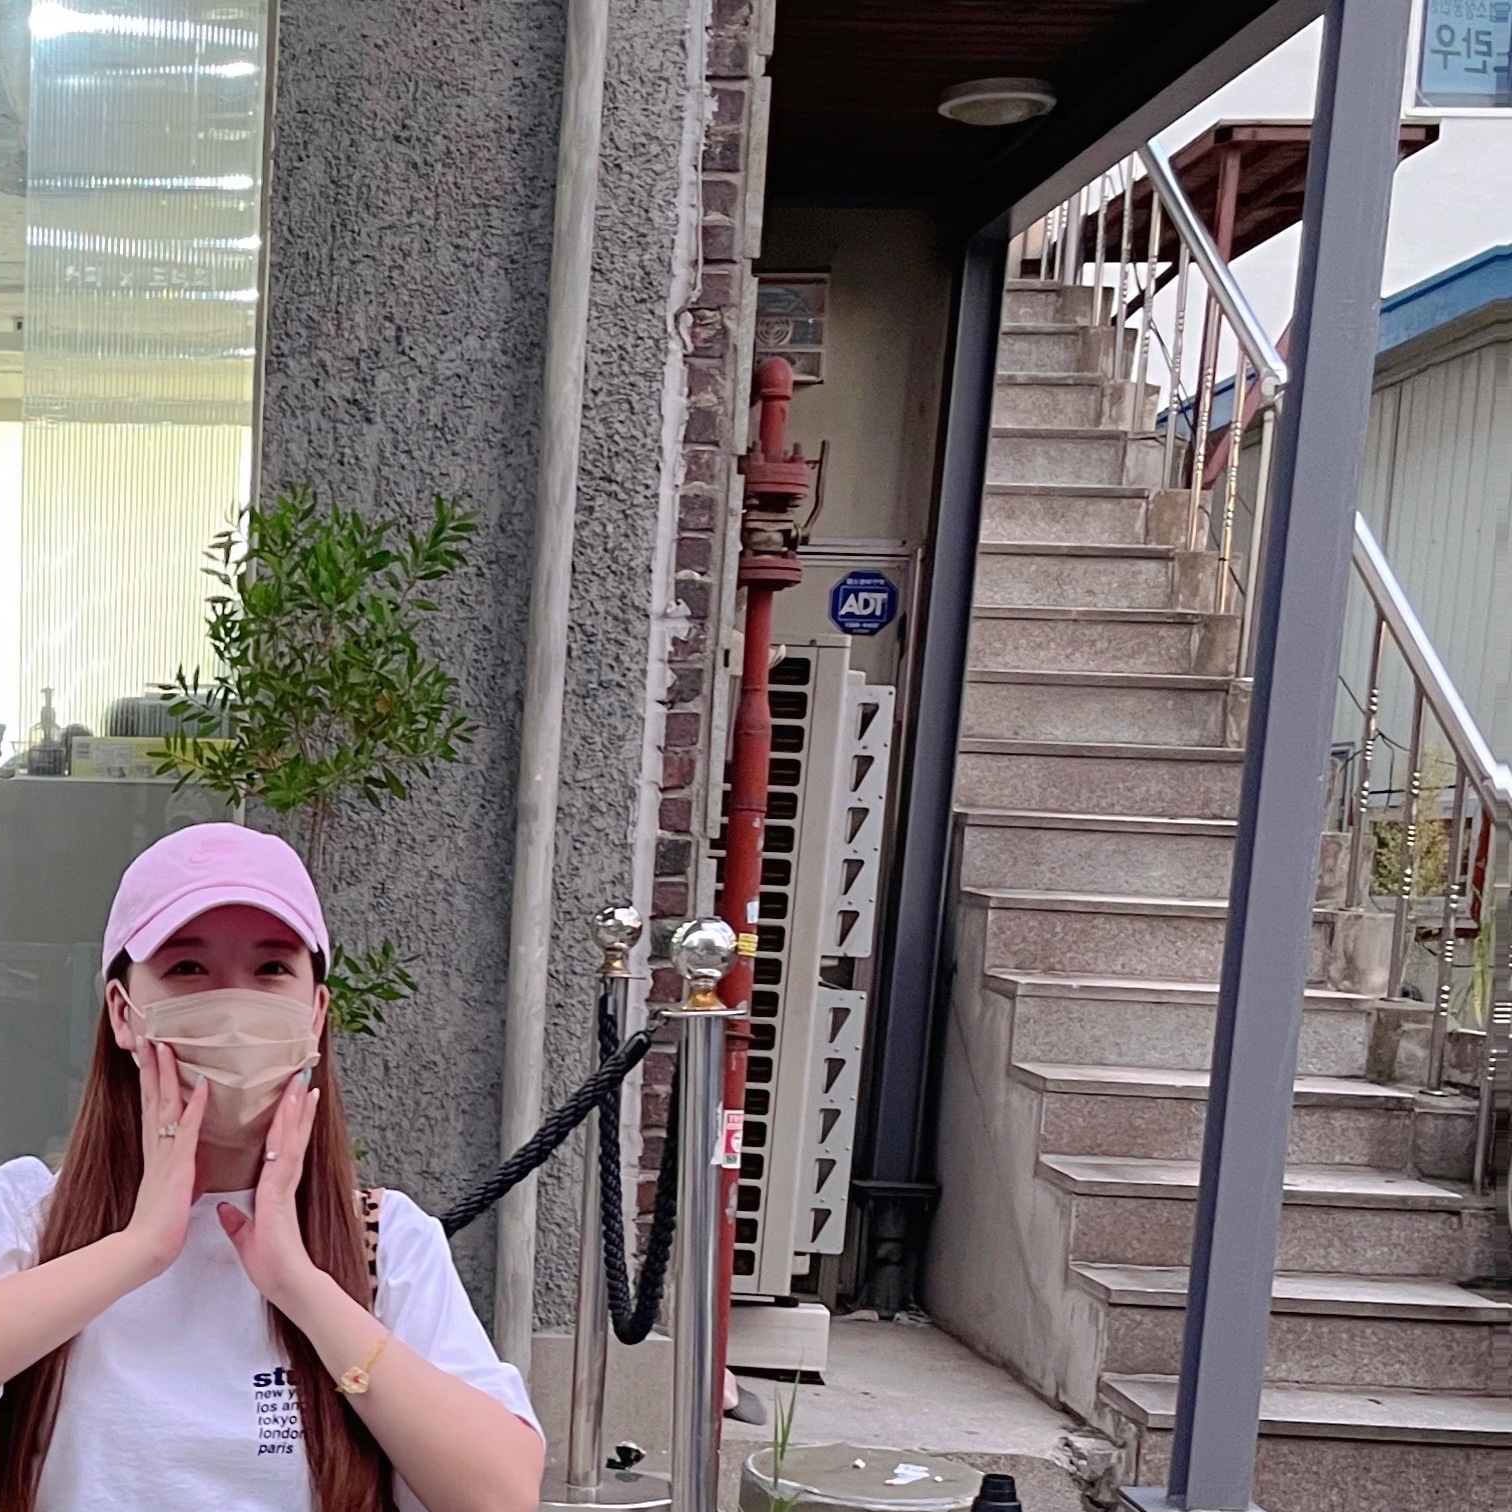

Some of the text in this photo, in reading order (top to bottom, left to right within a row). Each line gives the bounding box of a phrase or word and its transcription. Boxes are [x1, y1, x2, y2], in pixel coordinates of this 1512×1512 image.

[839, 592, 888, 616] ADT
[255, 1389, 284, 1400] new
[256, 1401, 278, 1414] los
[258, 1414, 298, 1428] tokyo
[257, 1441, 294, 1456] paris
